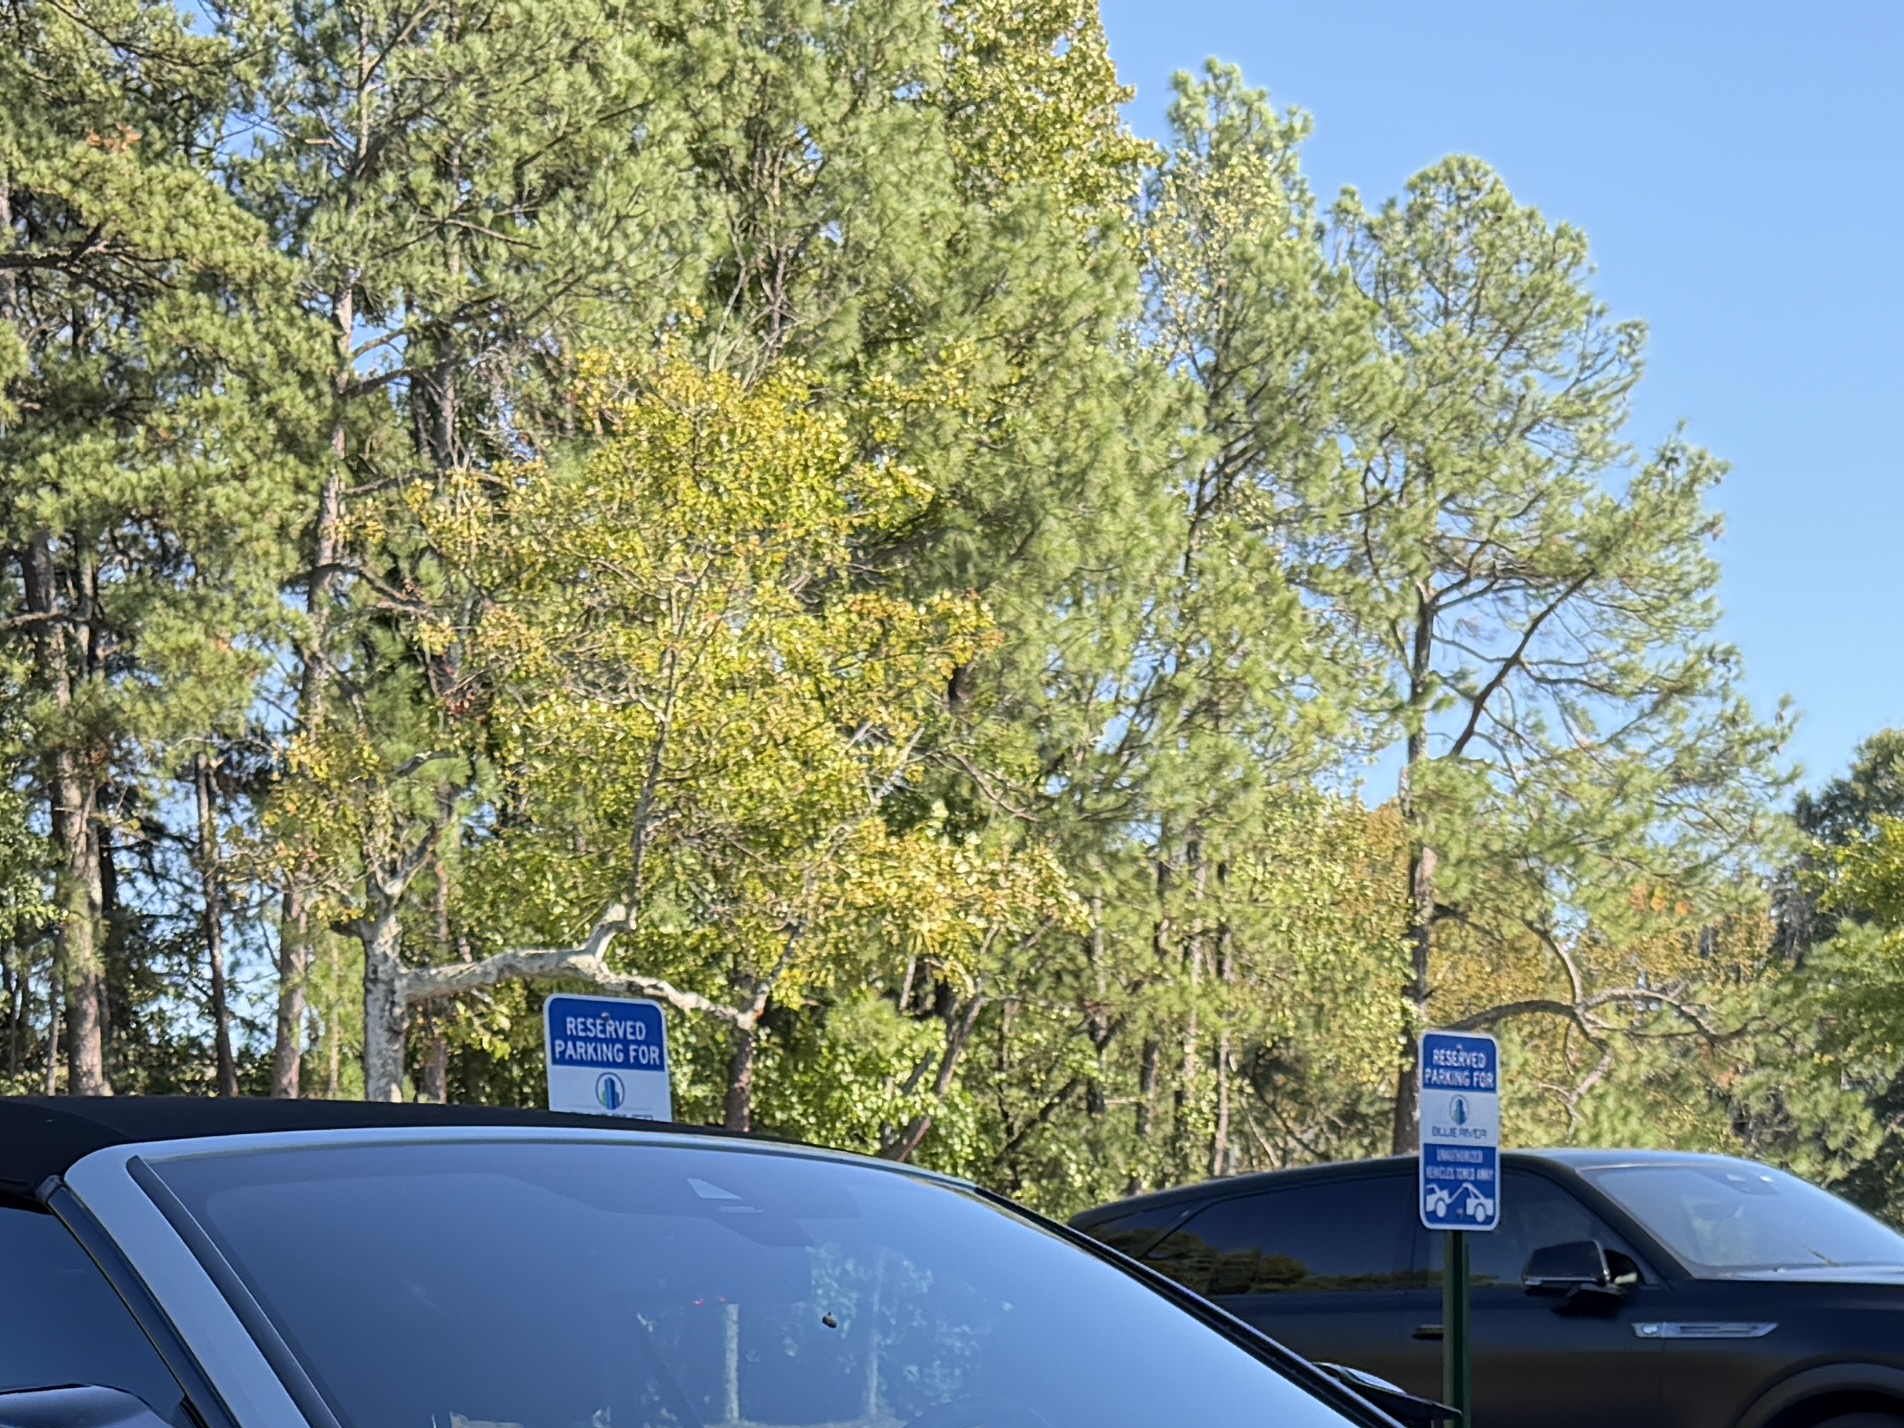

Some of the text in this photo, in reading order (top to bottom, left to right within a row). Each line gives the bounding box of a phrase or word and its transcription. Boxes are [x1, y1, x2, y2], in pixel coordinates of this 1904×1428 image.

[566, 1016, 646, 1041] RESERVED
[555, 1039, 660, 1066] PARKING FOR
[1432, 1049, 1486, 1068] RESERVED
[1424, 1067, 1494, 1088] PARKING FOR
